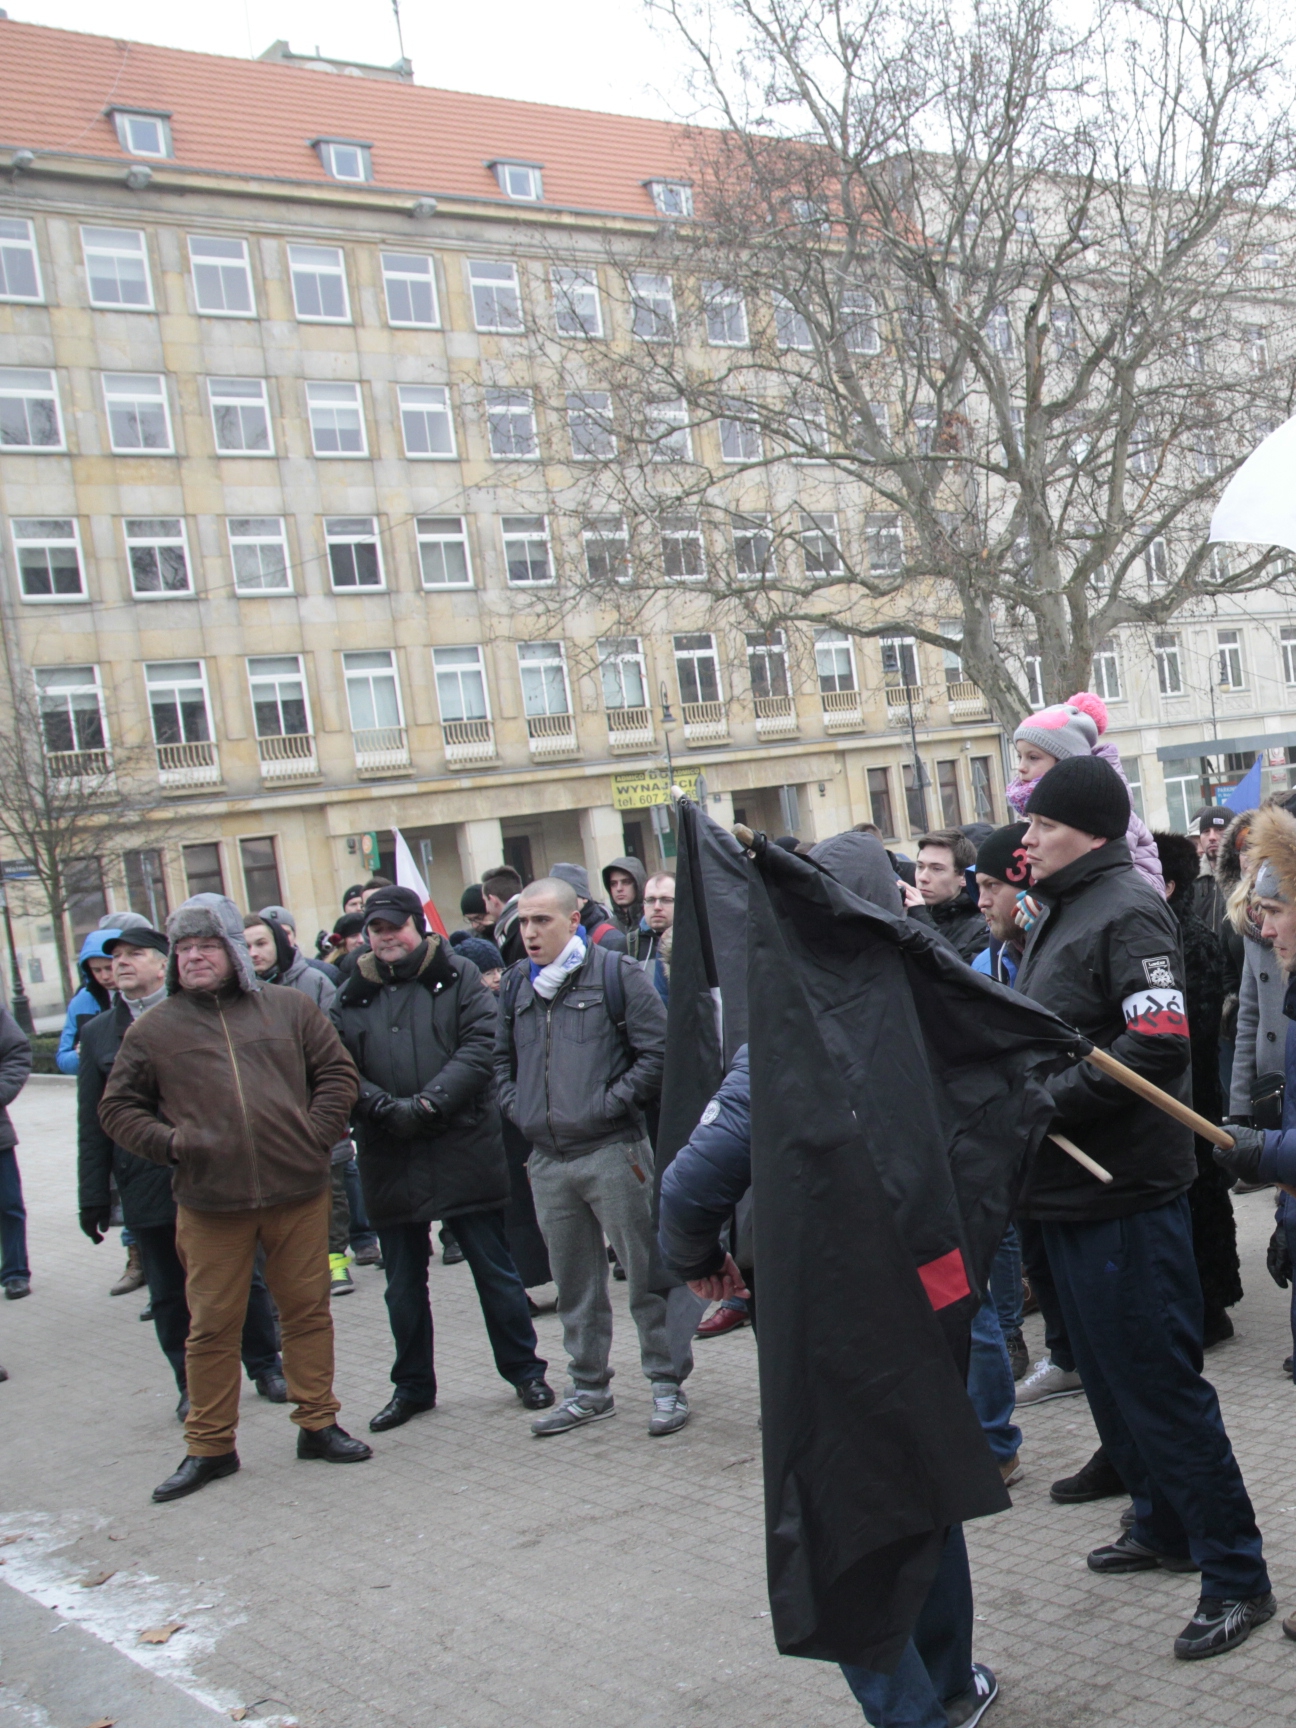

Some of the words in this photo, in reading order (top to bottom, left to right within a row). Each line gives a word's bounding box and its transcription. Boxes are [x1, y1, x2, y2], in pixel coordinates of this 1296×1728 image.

[616, 779, 698, 795] WYNAJCI
[618, 797, 636, 807] tel.
[639, 793, 659, 805] 607
